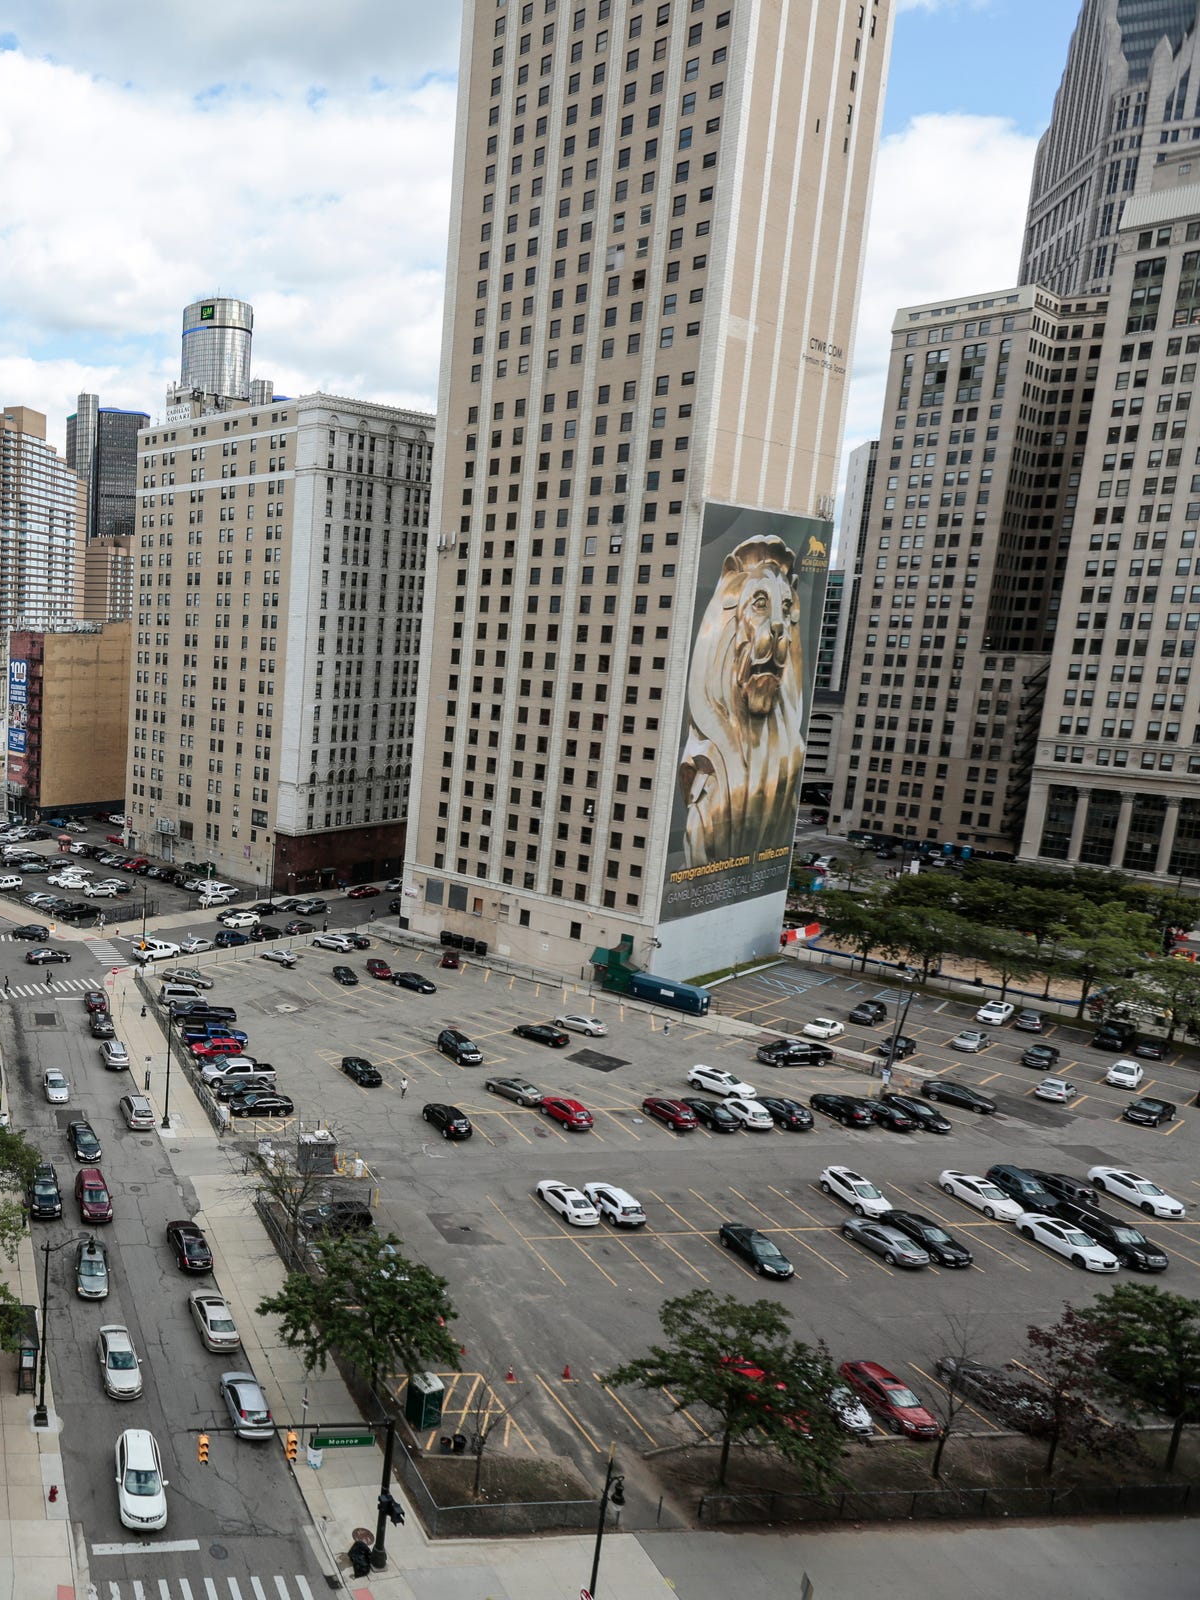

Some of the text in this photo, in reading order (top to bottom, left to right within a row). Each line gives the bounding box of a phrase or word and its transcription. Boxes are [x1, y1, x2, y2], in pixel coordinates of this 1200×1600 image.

[202, 307, 213, 316] GM
[10, 661, 27, 682] 100
[670, 855, 750, 883] mgmgranddetroit.com
[667, 887, 704, 904] GAMBLING
[736, 874, 751, 886] CALL
[690, 895, 706, 908] FOR
[705, 886, 751, 905] CONFIDENTIAL
